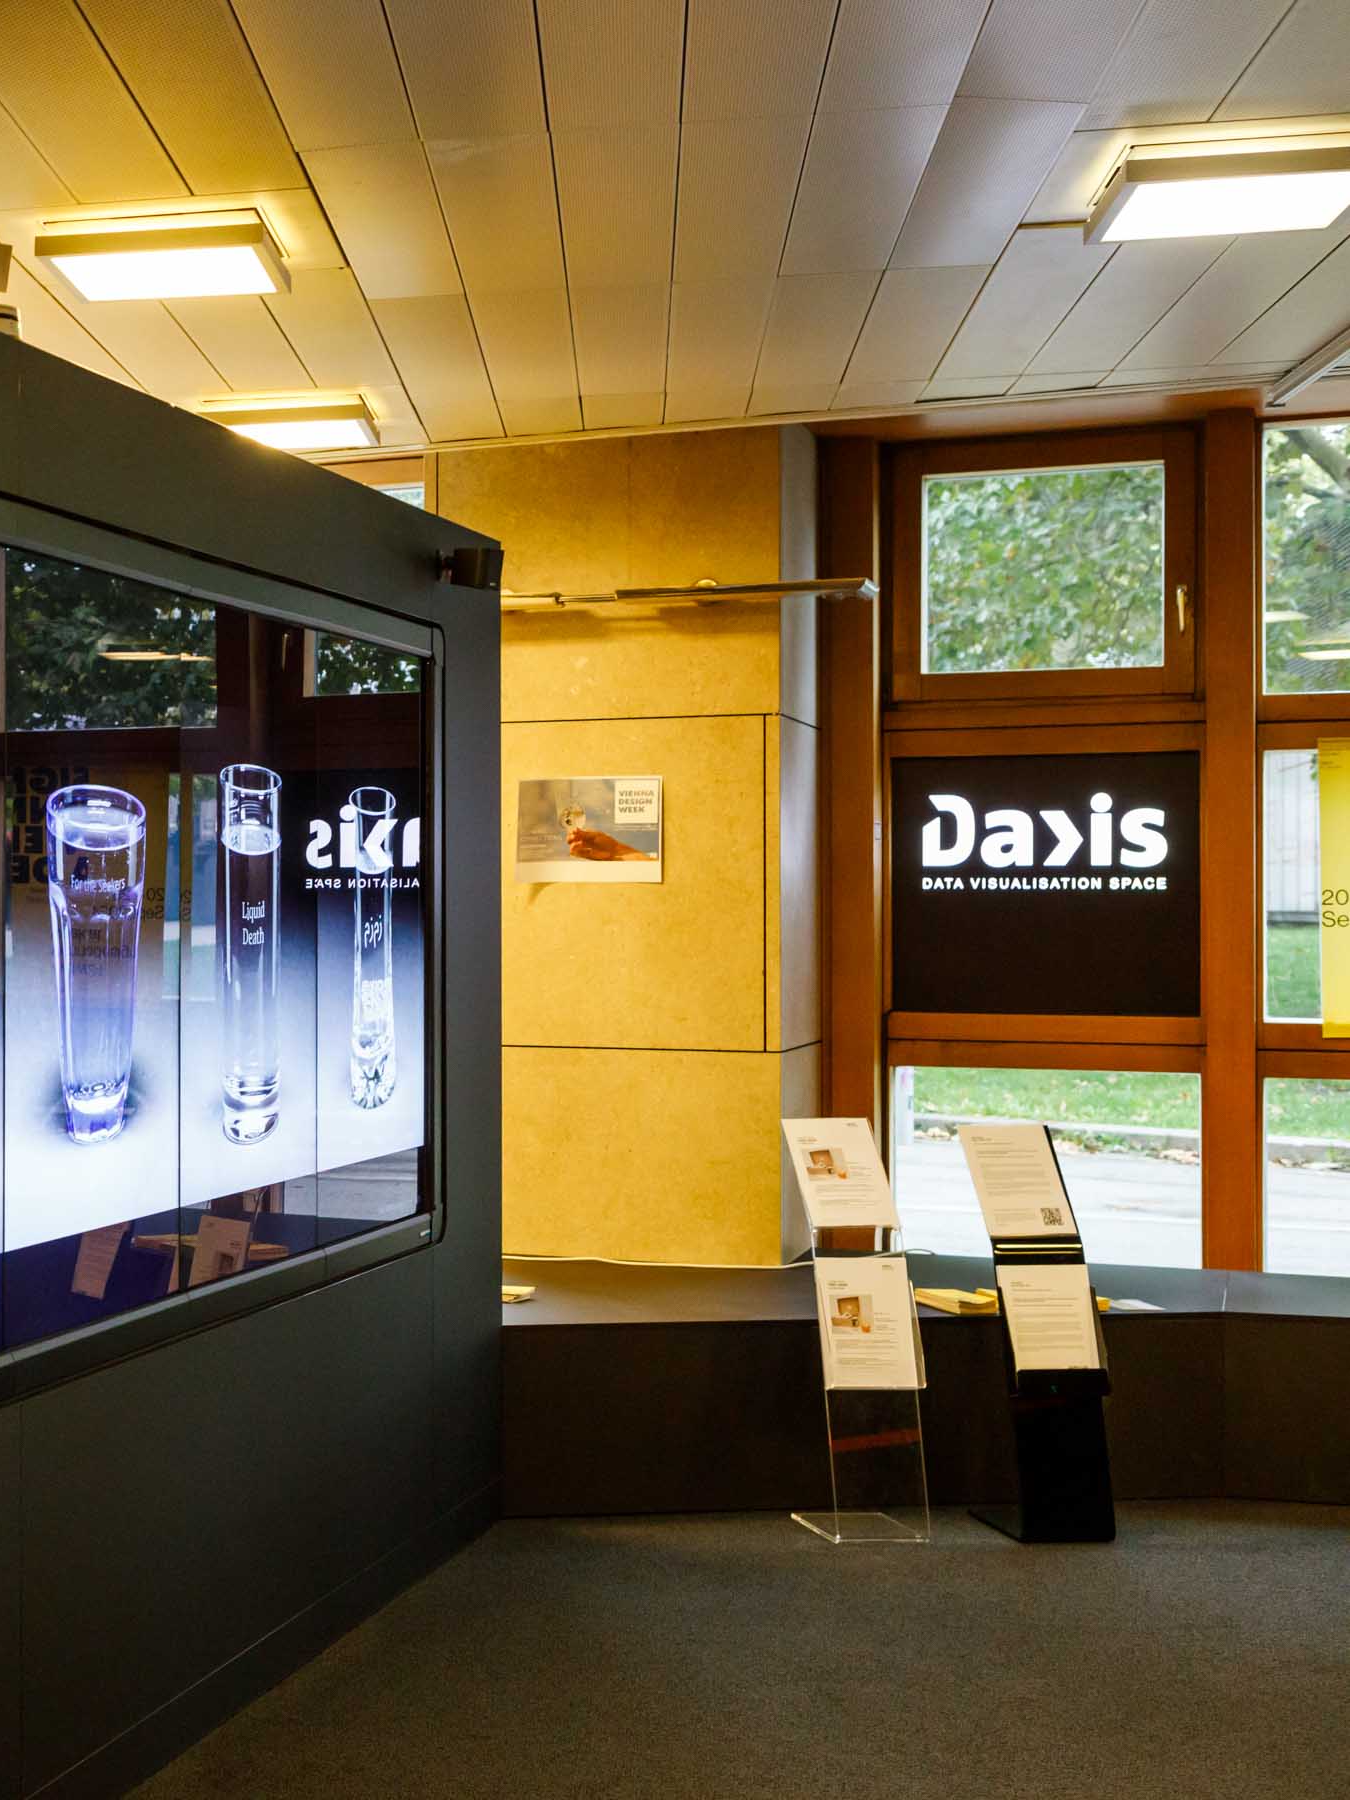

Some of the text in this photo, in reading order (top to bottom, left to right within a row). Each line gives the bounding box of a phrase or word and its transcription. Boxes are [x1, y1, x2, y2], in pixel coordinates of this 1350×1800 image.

[921, 877, 1168, 890] DATA VISUALISATION SPACE
[241, 900, 266, 924] Liquid
[242, 926, 265, 945] Death
